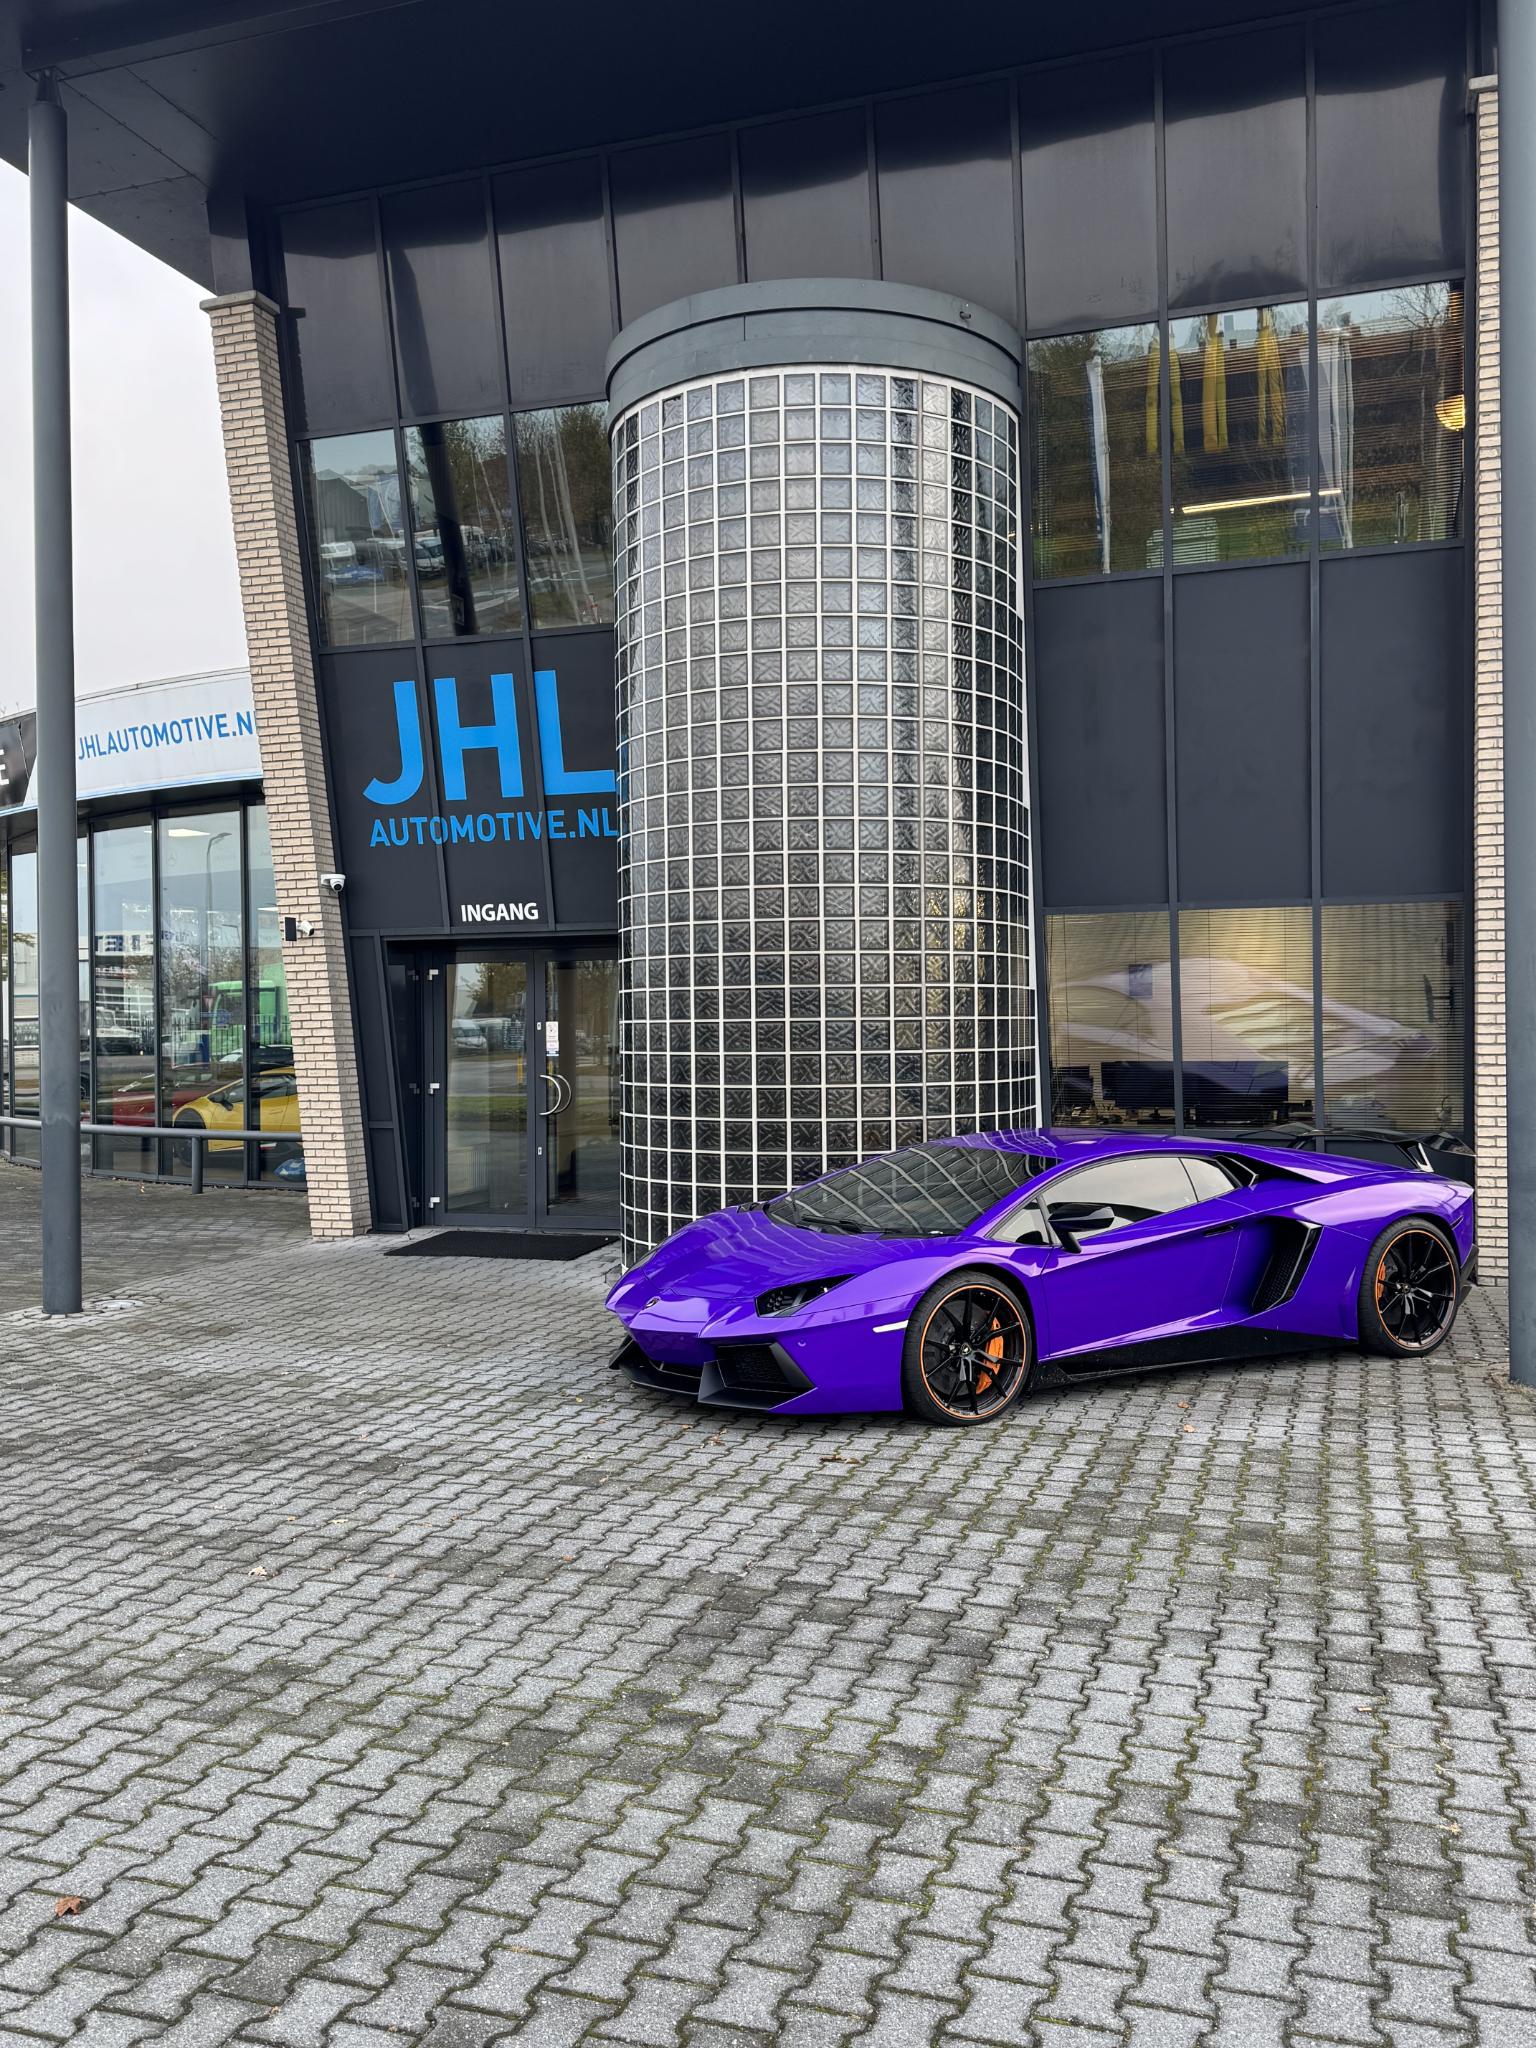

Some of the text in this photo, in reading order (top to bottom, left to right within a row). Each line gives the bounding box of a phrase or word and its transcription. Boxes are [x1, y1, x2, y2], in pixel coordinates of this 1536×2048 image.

[78, 710, 256, 761] JHLAUTOMOTIVE.N
[363, 669, 617, 806] JHL
[369, 807, 619, 848] AUTOMOTIVE.NL
[460, 902, 539, 922] INGANG
